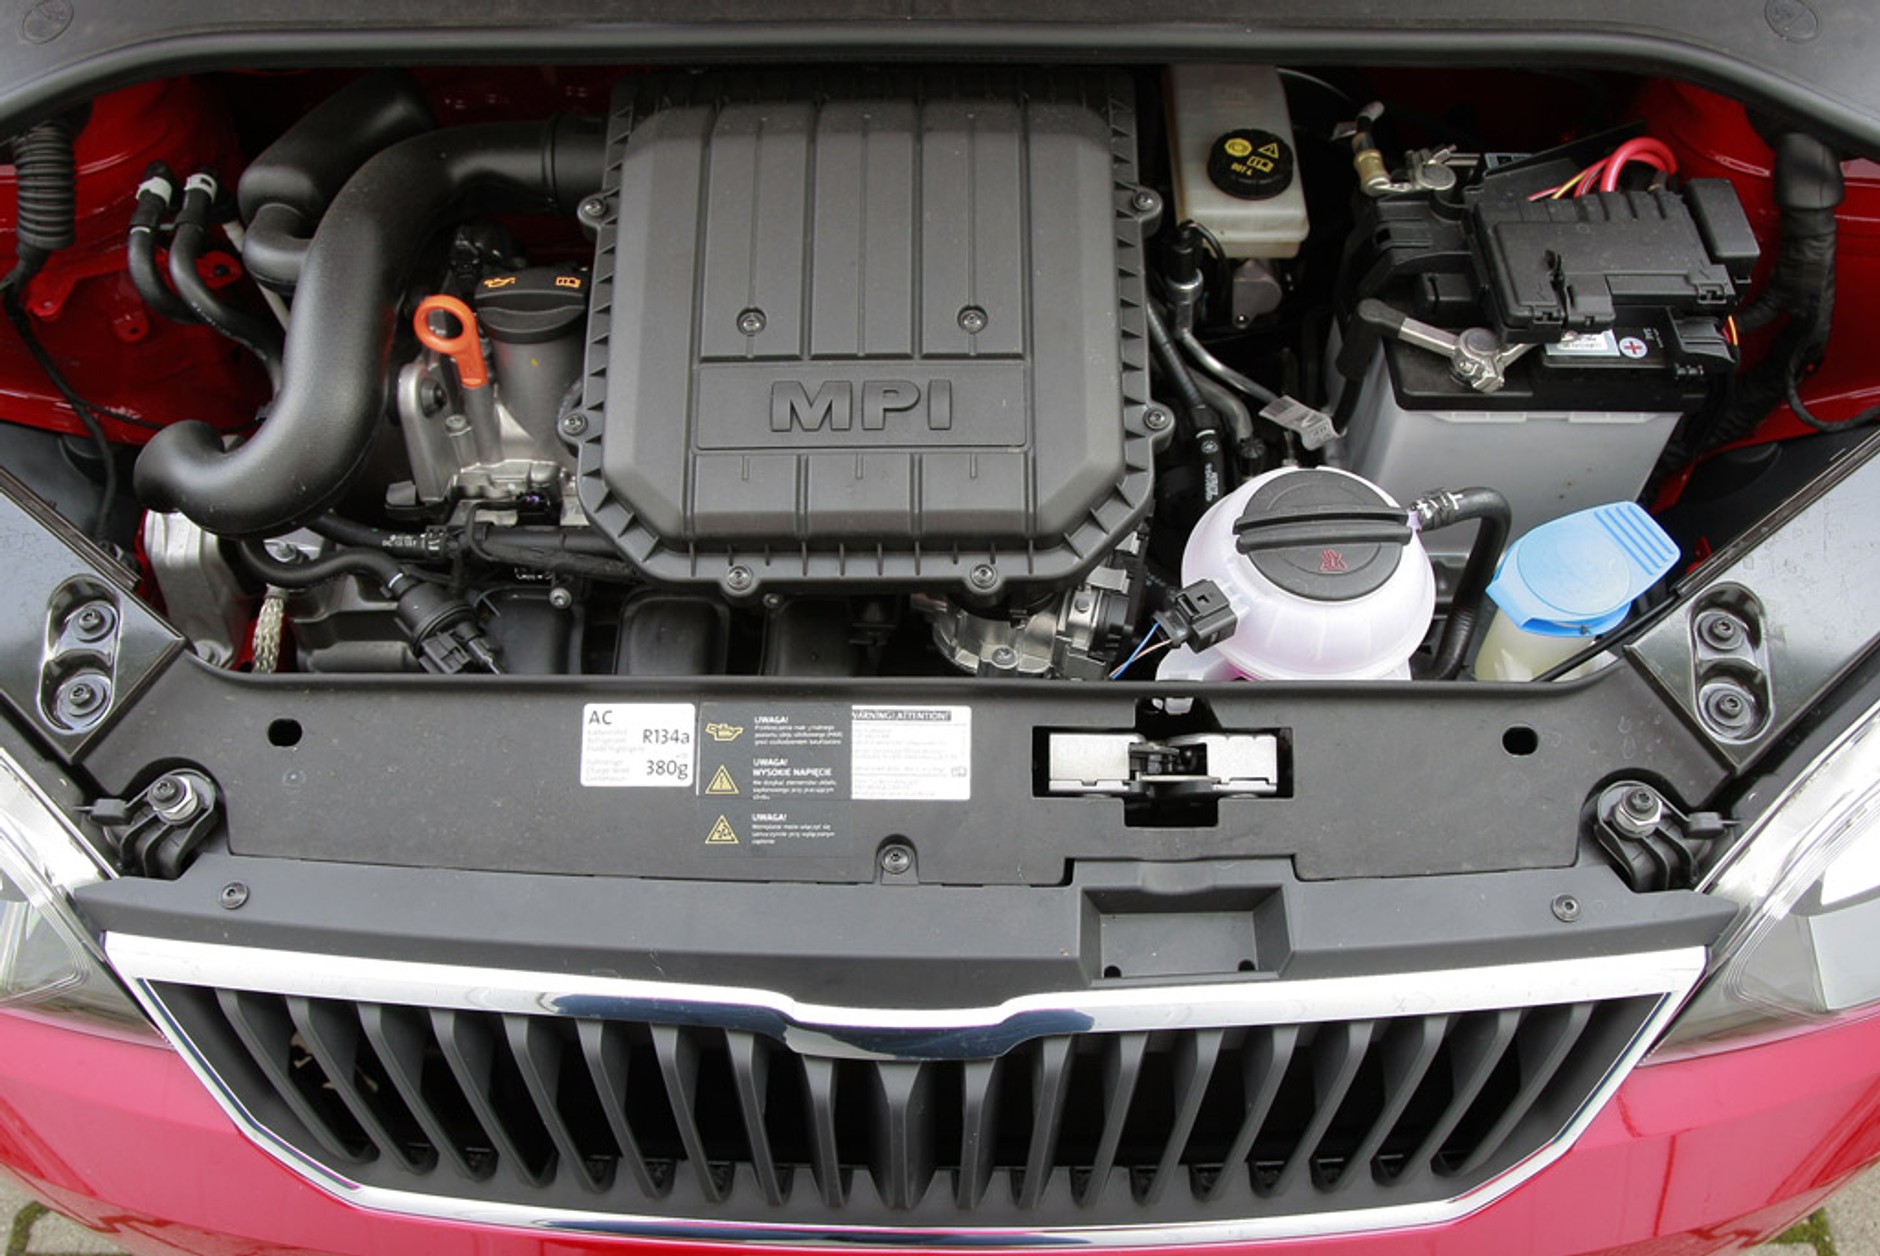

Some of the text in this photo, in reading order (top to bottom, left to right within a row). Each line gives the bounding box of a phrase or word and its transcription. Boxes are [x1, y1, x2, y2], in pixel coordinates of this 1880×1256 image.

[770, 379, 952, 432] MPI
[588, 710, 613, 725] AC
[755, 716, 789, 724] UWAGA!
[643, 729, 690, 745] R134a
[753, 758, 789, 767] UWAGA!
[646, 760, 688, 781] 380g
[752, 813, 787, 822] UWAGA!
